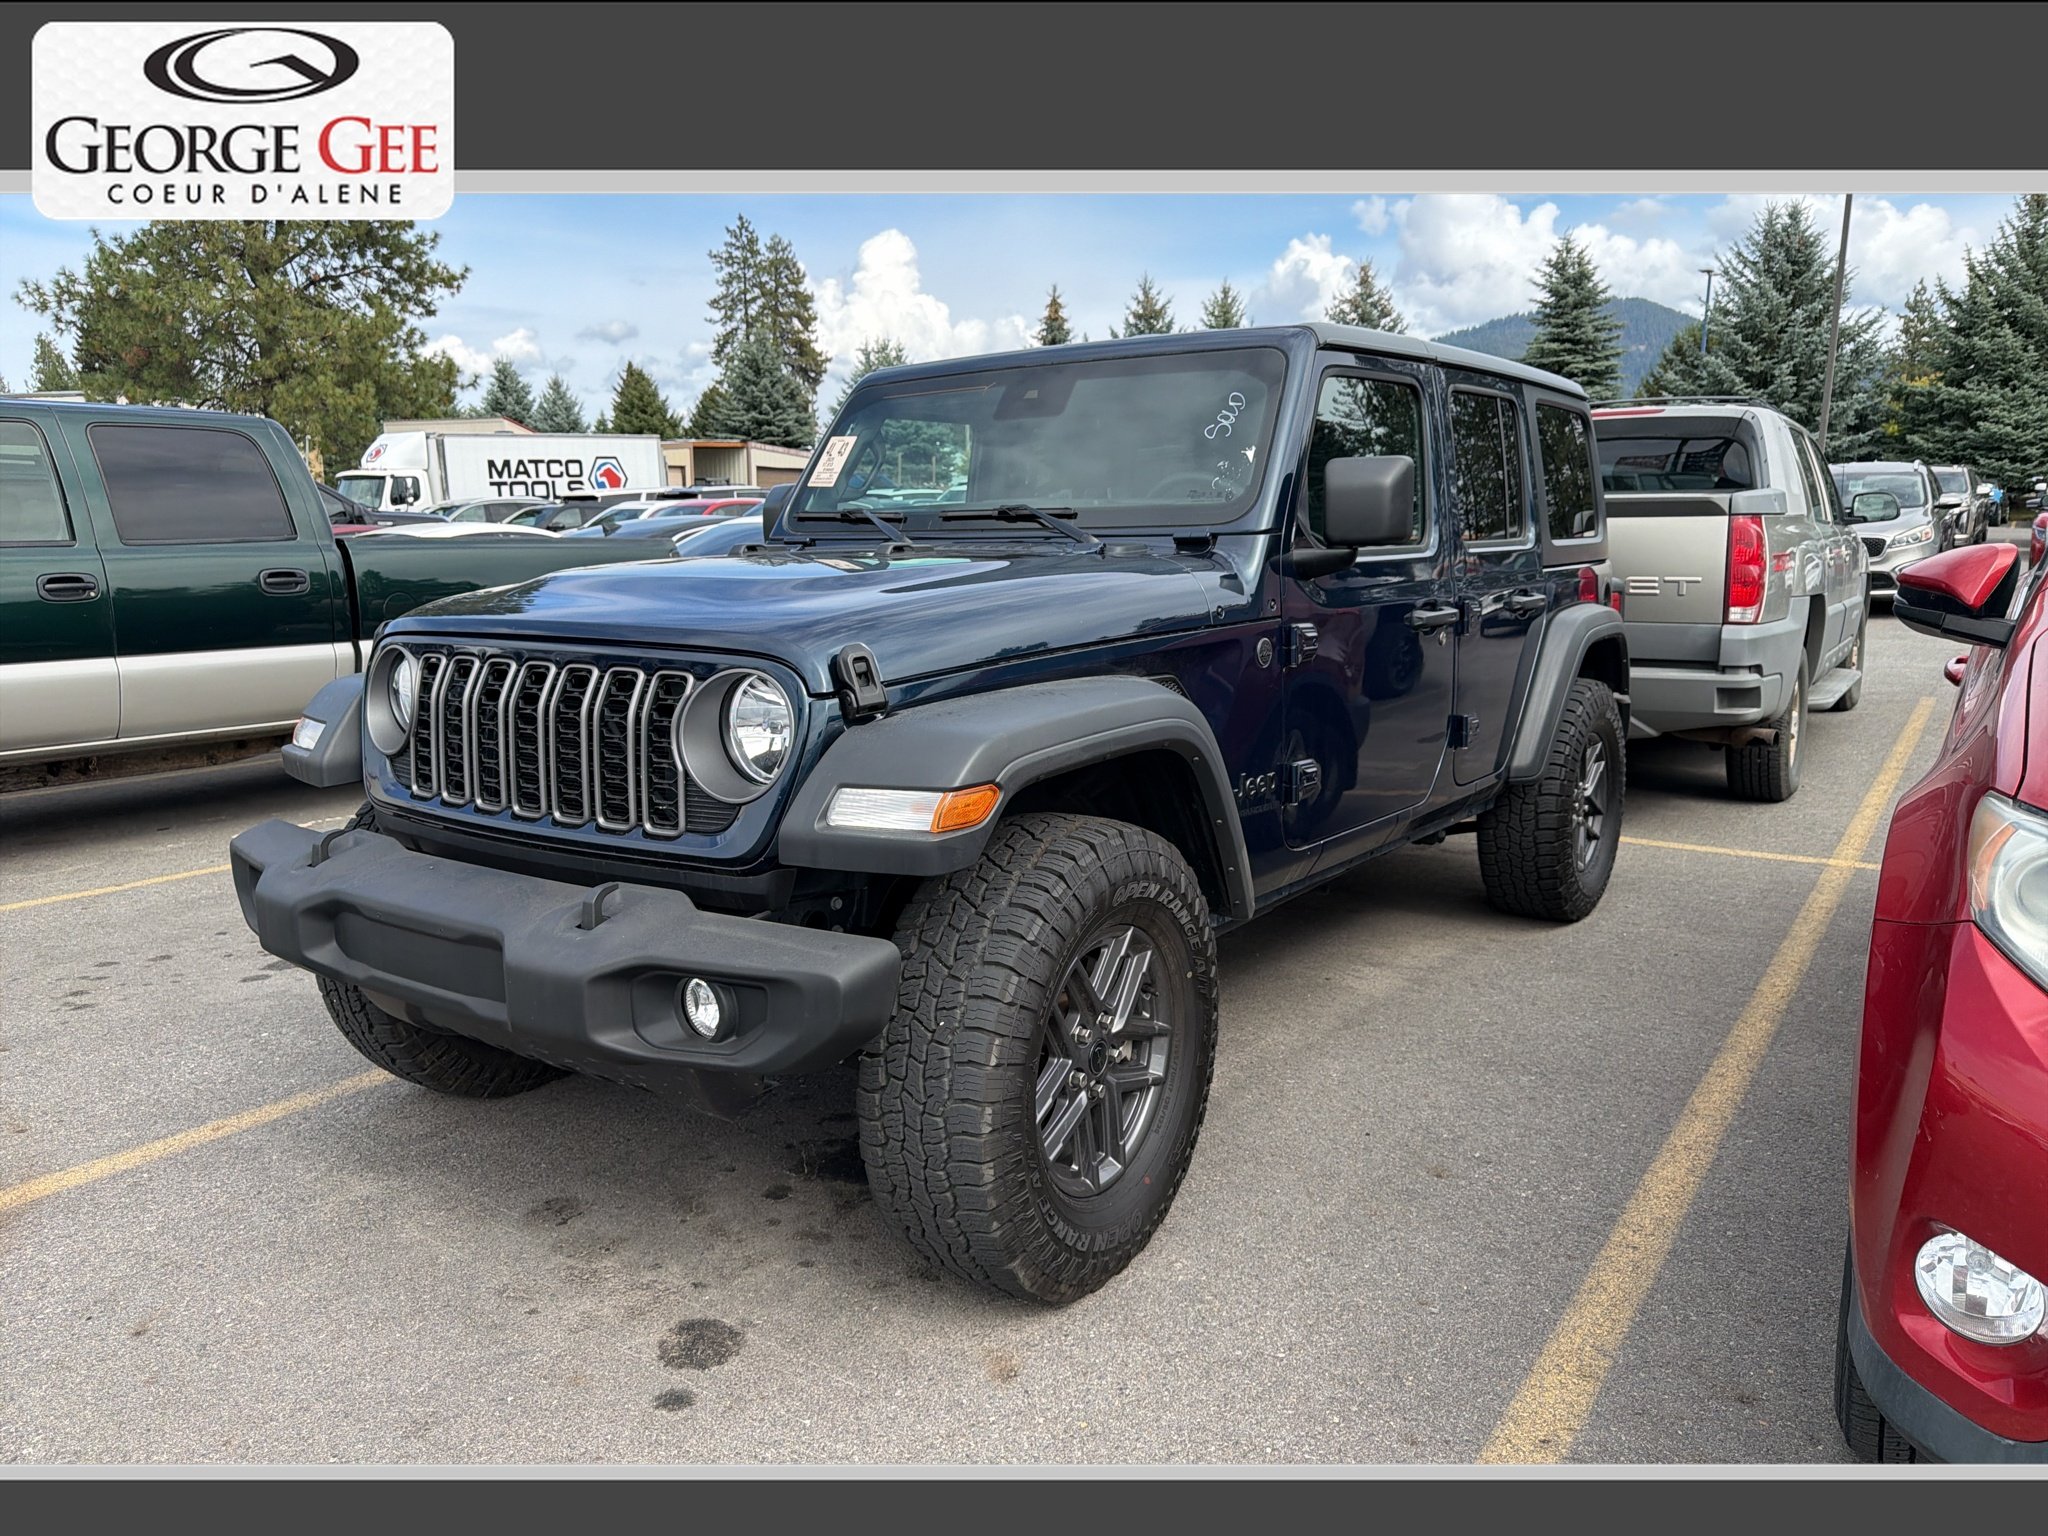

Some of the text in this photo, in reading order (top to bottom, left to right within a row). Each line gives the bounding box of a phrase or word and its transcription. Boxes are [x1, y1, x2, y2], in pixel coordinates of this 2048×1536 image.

[487, 459, 584, 479] MATCO
[489, 480, 586, 499] TOOLS
[1232, 771, 1277, 798] Jeep
[1112, 880, 1160, 907] OPEN
[1158, 887, 1202, 951] RANGE
[1038, 1195, 1092, 1252] RANGE
[1092, 1208, 1142, 1252] OPEN
